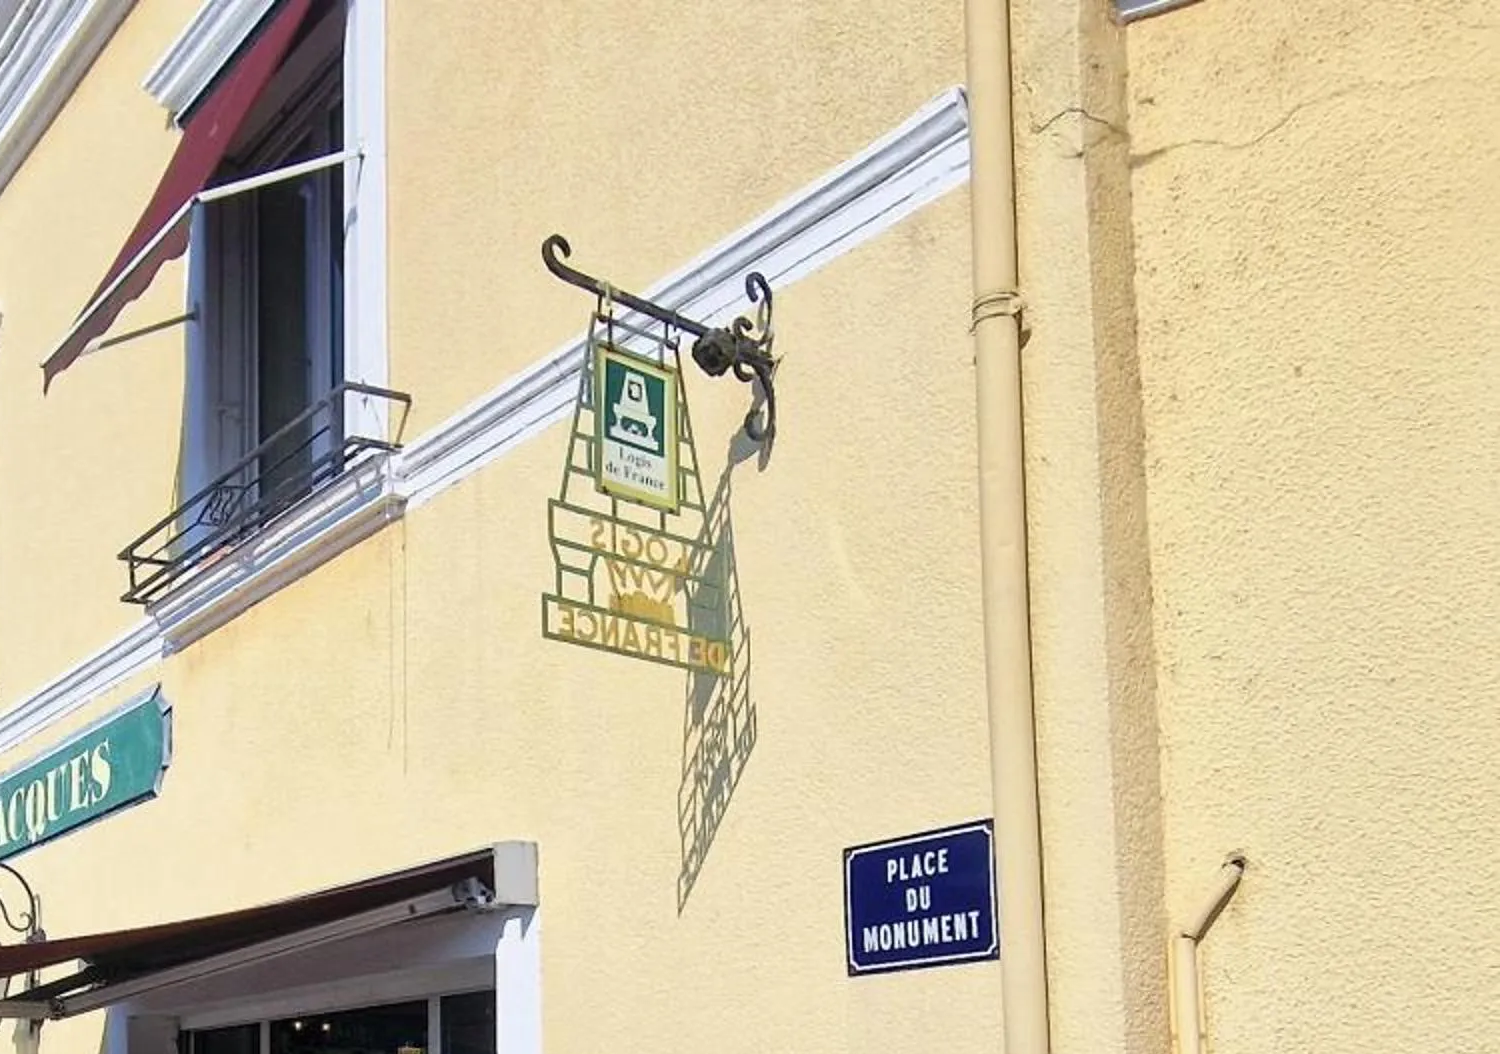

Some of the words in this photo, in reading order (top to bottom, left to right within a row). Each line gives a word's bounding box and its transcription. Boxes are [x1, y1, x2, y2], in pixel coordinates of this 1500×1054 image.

[887, 849, 949, 883] PLACE
[906, 886, 931, 913] DU
[863, 910, 980, 953] MONUMENT
